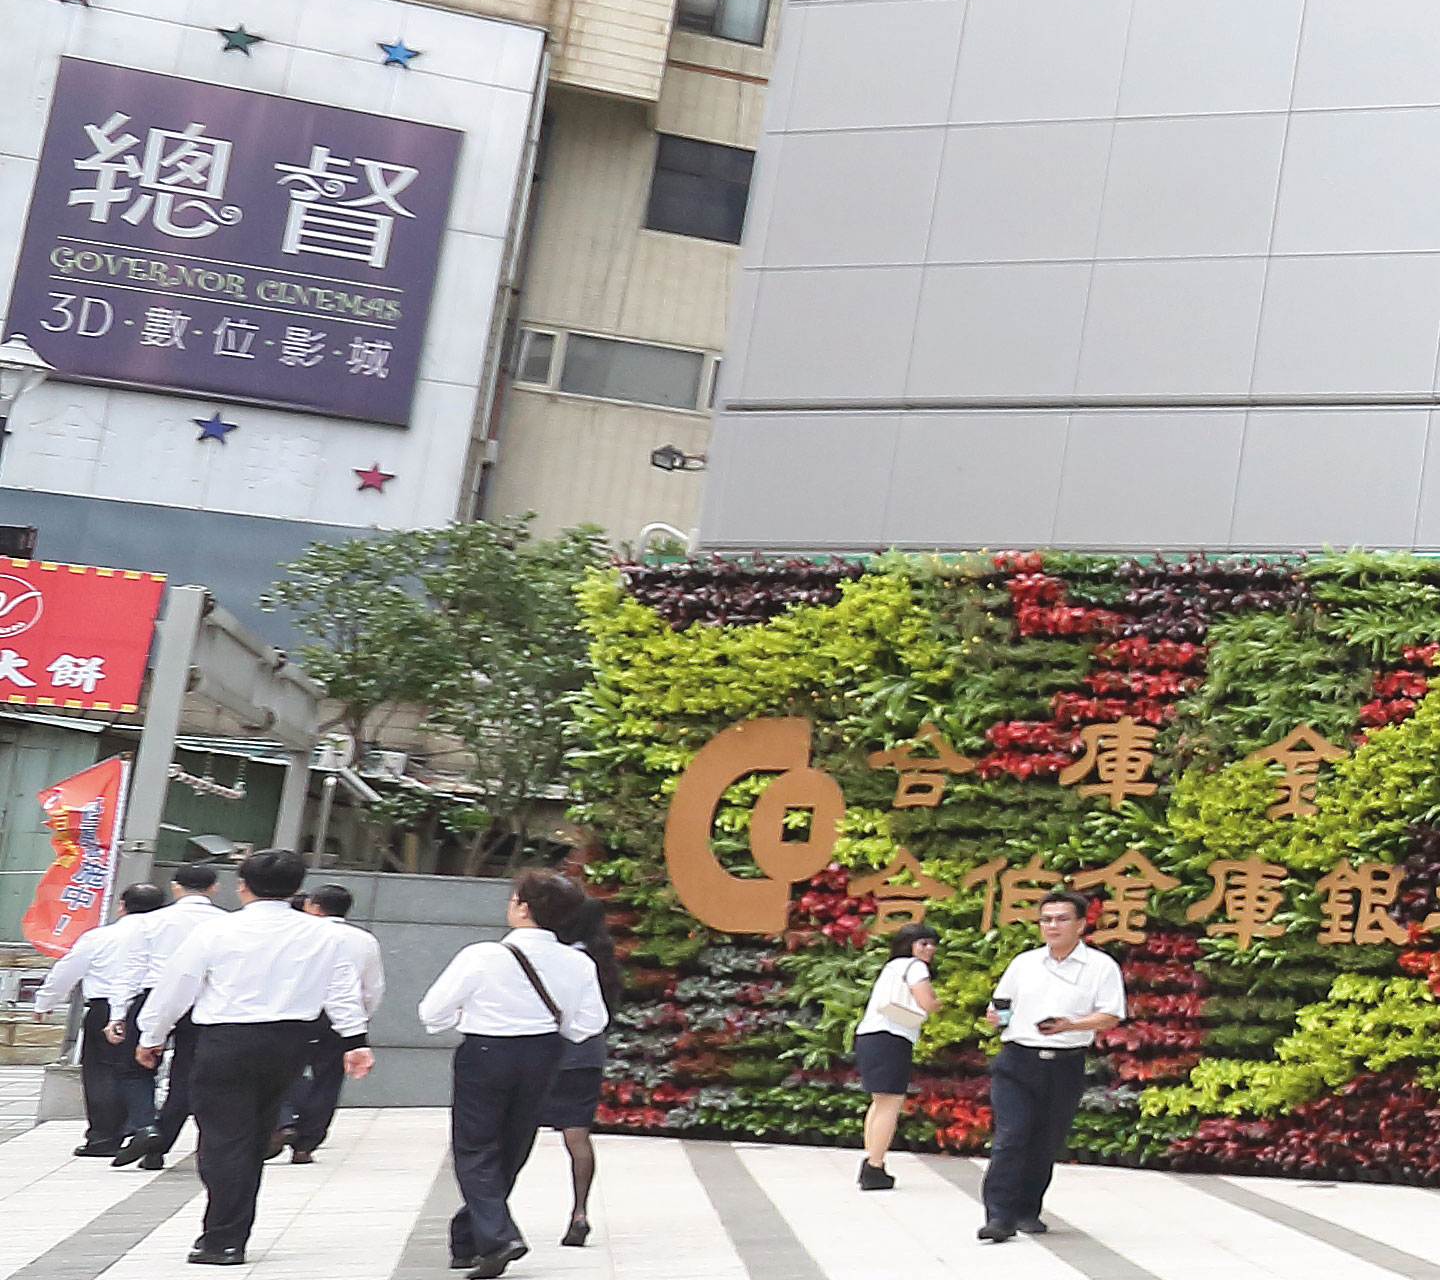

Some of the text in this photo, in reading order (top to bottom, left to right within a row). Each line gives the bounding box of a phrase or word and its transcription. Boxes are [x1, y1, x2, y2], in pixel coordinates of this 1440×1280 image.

[66, 110, 419, 270] 總督
[48, 245, 403, 321] GOVERNOR CINEMAS
